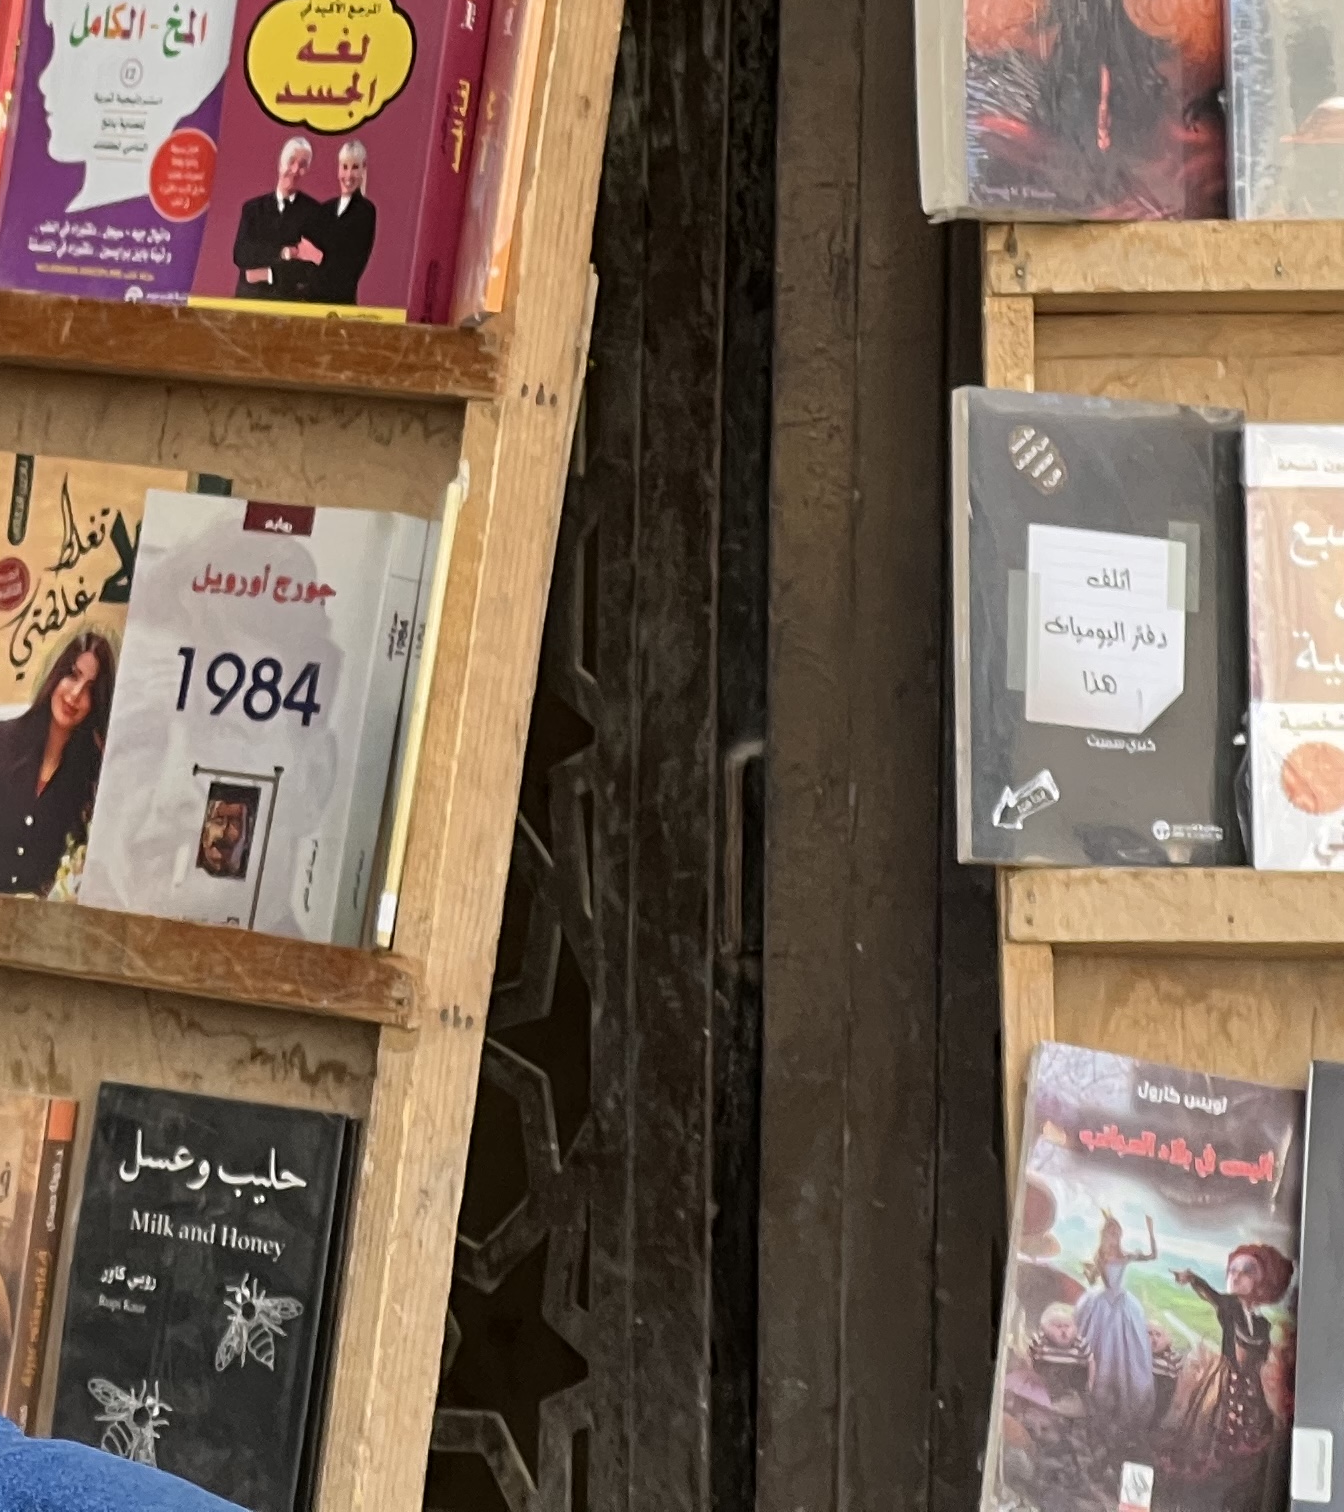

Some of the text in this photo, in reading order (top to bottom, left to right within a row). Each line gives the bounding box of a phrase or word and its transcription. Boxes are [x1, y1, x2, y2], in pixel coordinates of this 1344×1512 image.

[69, 1, 147, 48] الكامل
[296, 22, 373, 65] لغة
[274, 70, 378, 121] الجسد
[190, 563, 338, 606] جورج أورويل
[175, 645, 322, 727] 1984
[1082, 668, 1118, 696] هذا
[118, 1128, 211, 1191] وعسل
[216, 1146, 308, 1205] حليب
[128, 1207, 287, 1264] Milk and Honey
